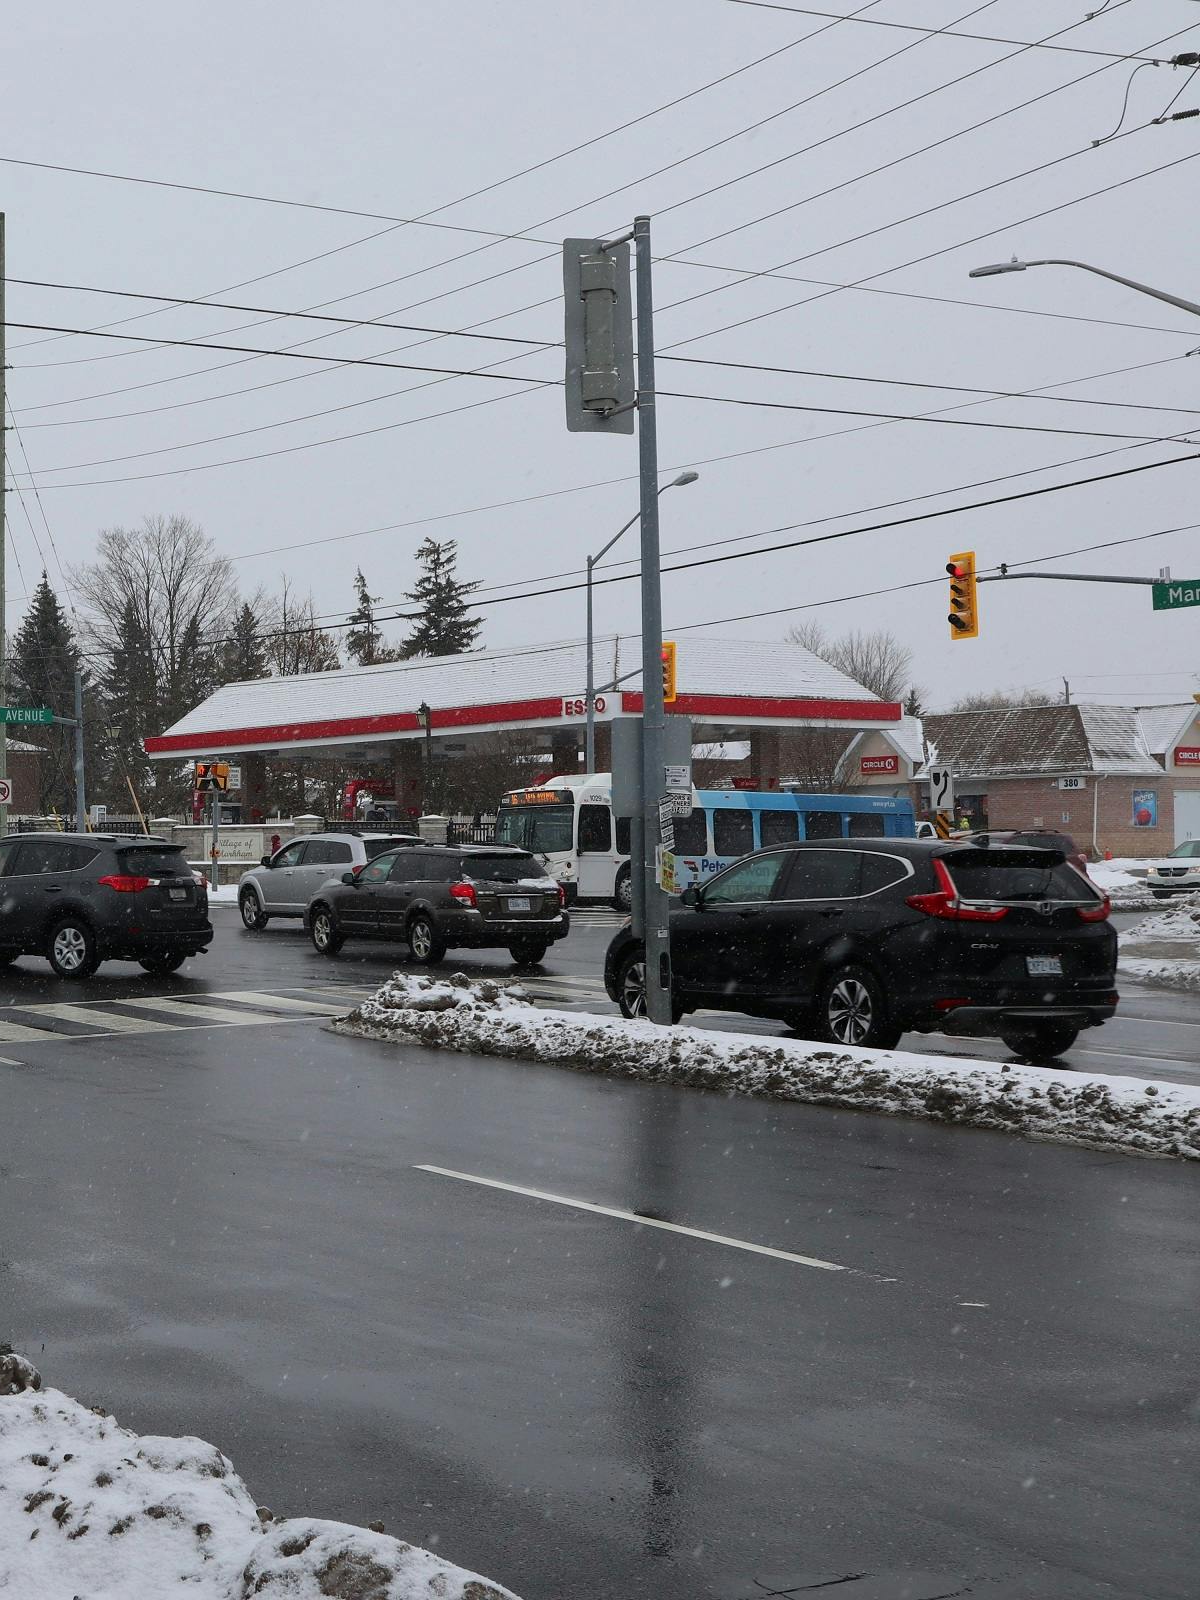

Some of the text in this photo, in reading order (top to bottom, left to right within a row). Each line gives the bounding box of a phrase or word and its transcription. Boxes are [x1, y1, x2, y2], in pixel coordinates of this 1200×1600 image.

[565, 697, 606, 715] ESO
[5, 709, 45, 722] AVENUE
[1179, 751, 1198, 760] CIRCLE
[863, 758, 894, 769] CIRCLE K
[1063, 779, 1079, 788] 380
[590, 794, 602, 802] 1029
[701, 858, 728, 873] Pete
